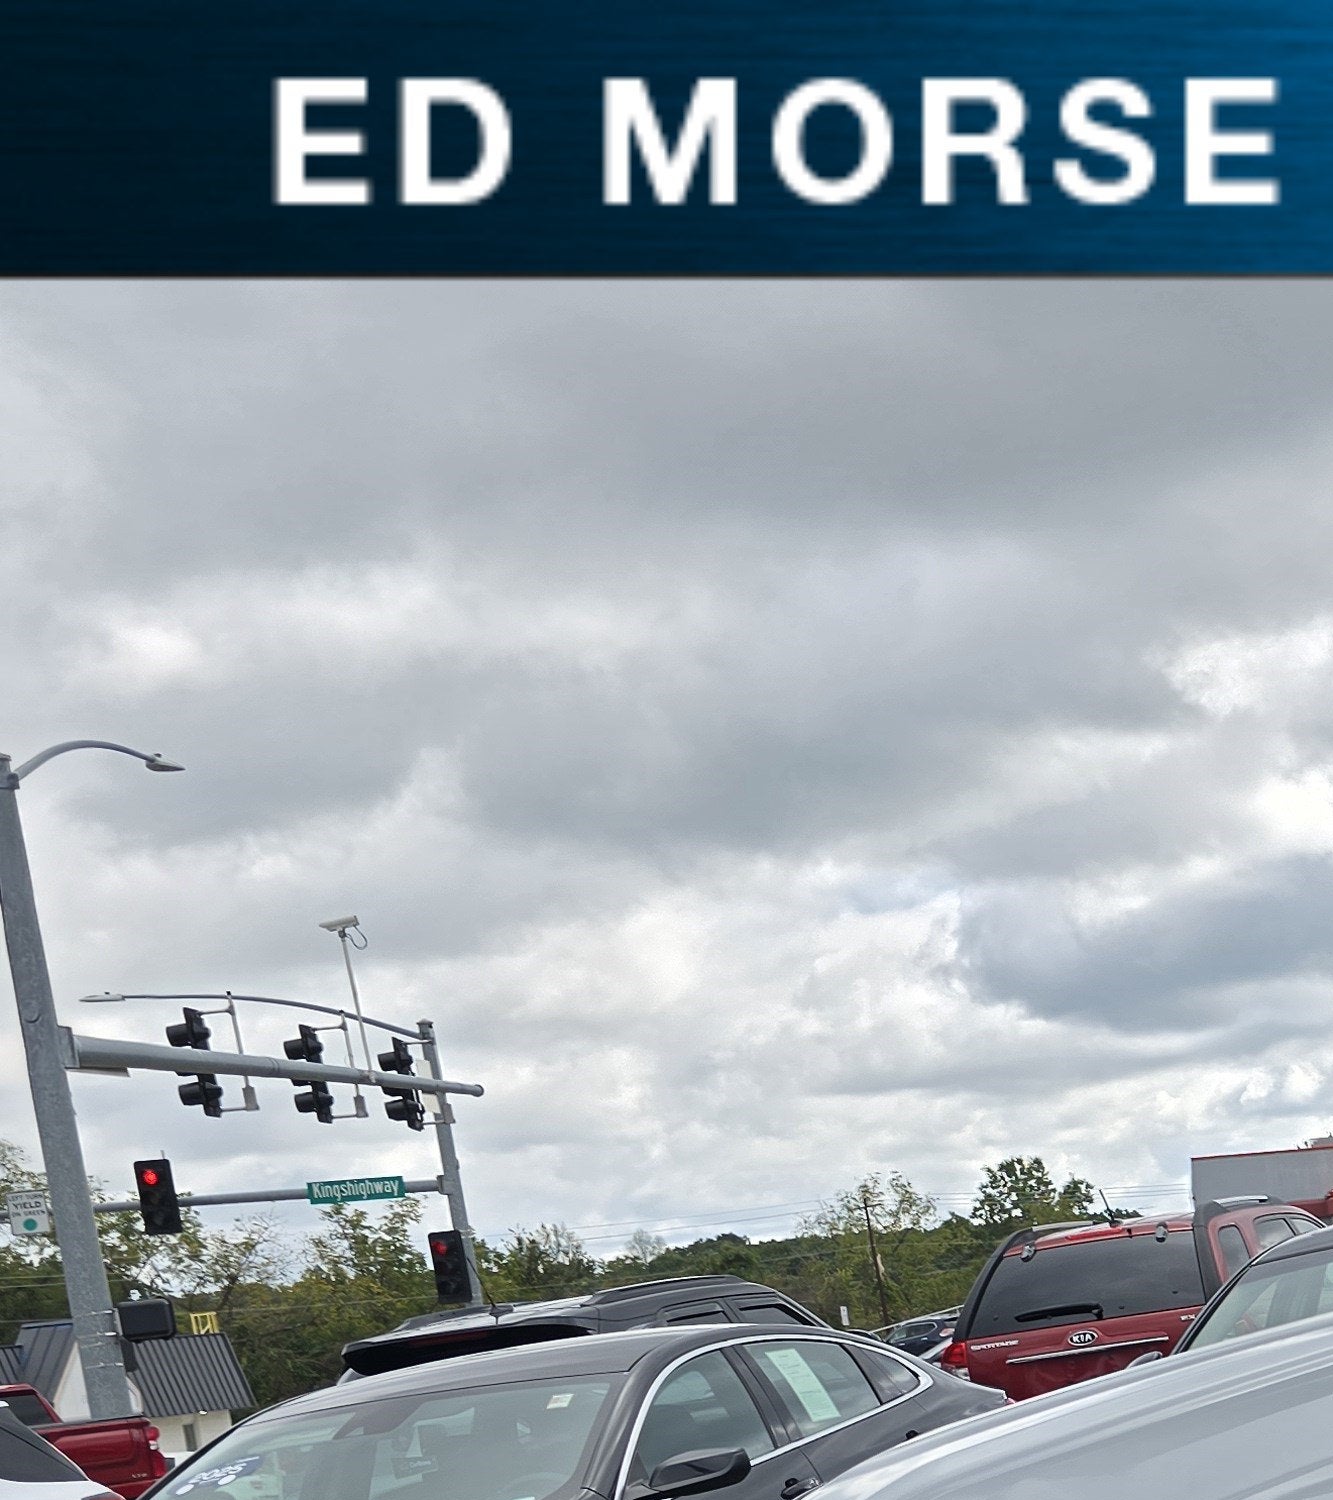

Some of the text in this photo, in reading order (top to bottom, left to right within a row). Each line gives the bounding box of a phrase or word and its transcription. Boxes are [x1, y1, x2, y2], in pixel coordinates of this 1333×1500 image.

[311, 1180, 399, 1201] Kingshighway
[12, 1201, 41, 1209] YIELD
[1072, 1333, 1093, 1343] KIA
